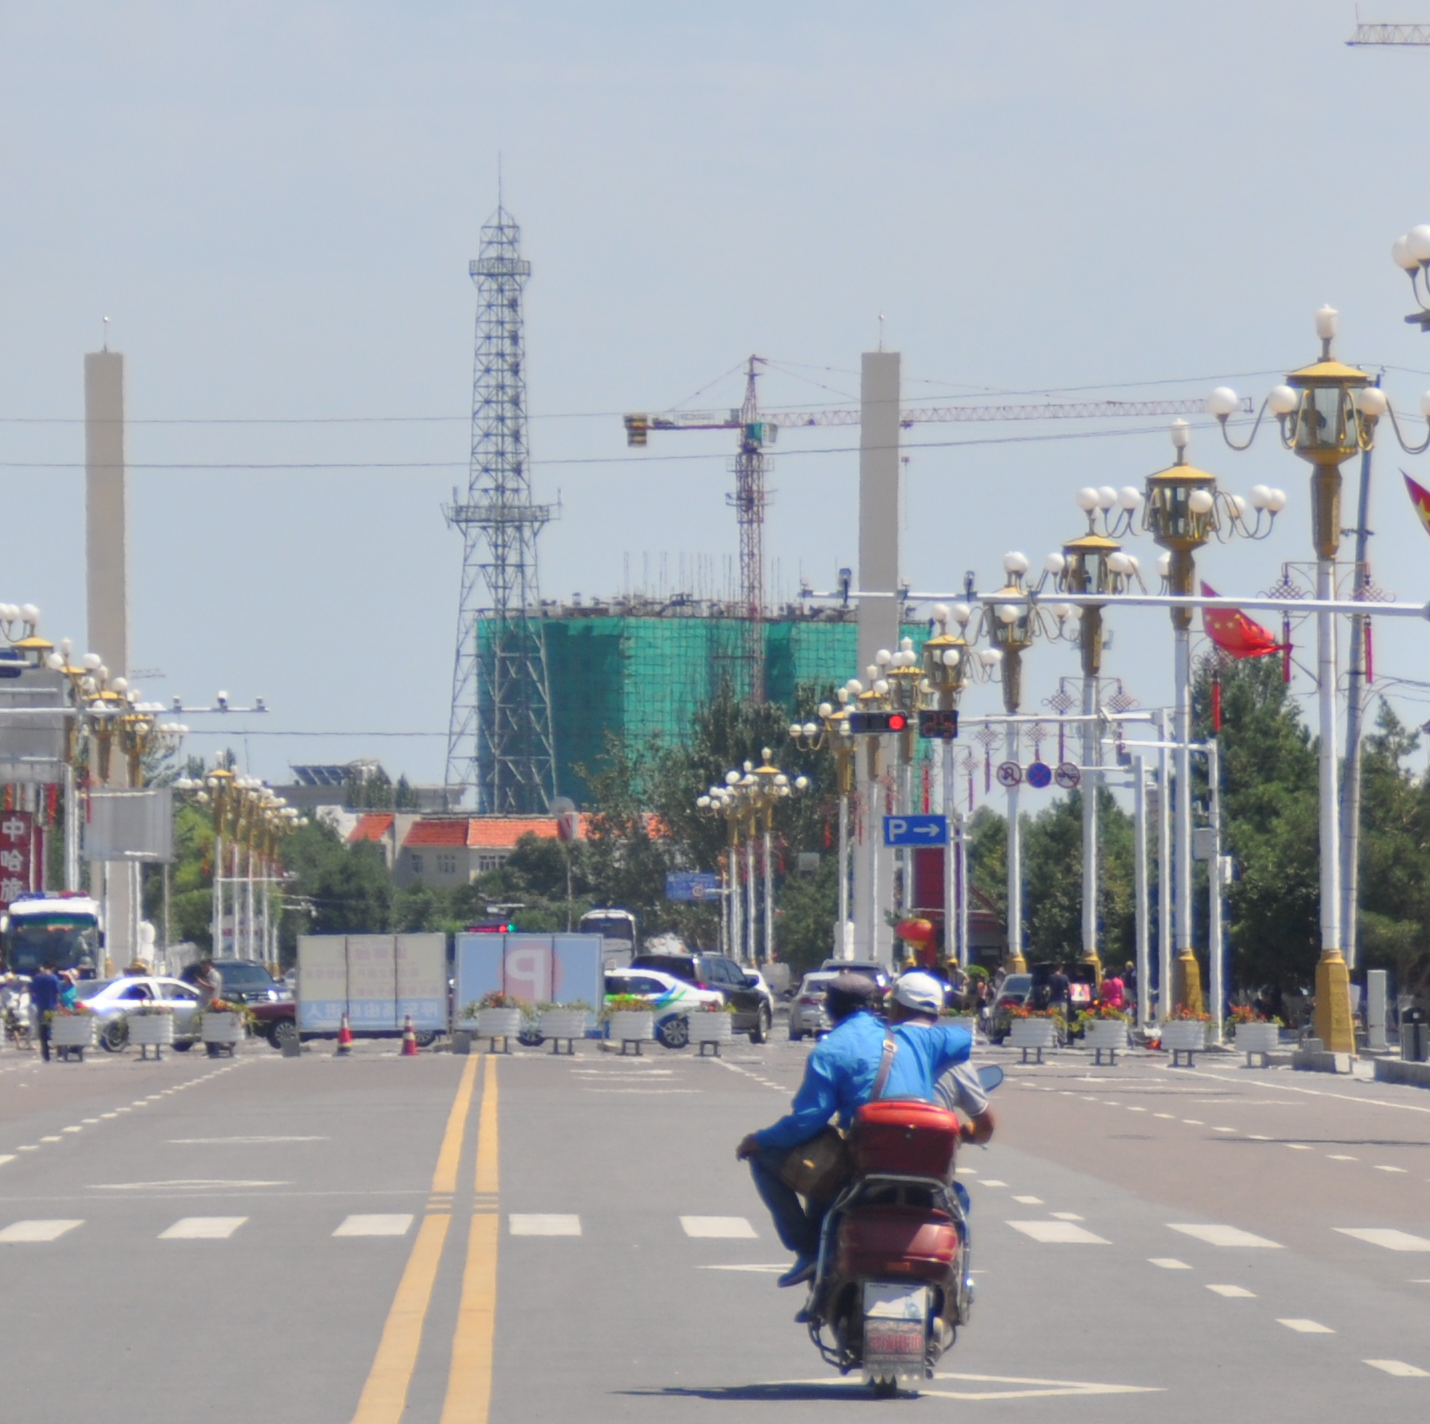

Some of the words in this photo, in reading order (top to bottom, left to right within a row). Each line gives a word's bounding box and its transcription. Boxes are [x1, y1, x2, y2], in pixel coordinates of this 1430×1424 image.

[888, 820, 906, 842] P
[0, 816, 25, 912] 中哈旅
